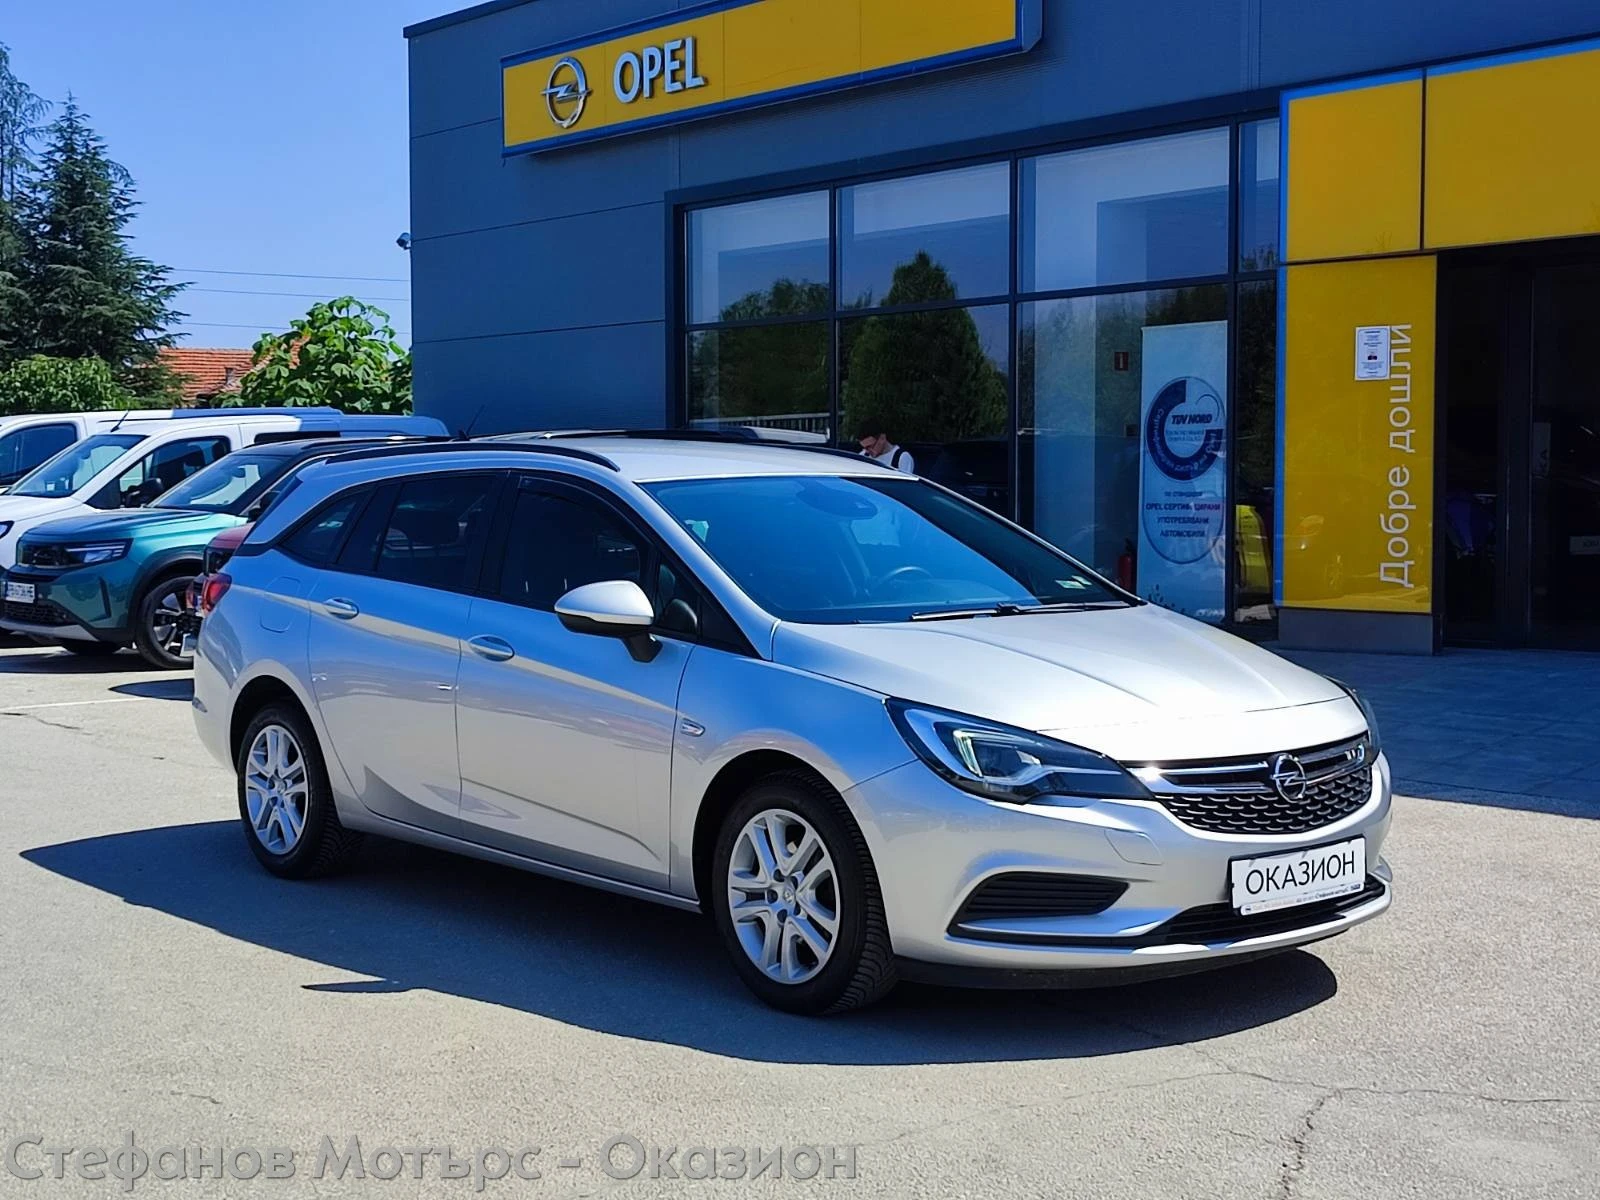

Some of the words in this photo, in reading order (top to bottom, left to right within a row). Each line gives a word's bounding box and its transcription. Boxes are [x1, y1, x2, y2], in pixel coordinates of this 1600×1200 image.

[613, 36, 705, 103] OPEL
[1188, 414, 1212, 424] NORD
[1388, 323, 1416, 453] дошли
[1379, 465, 1416, 588] Добре
[1245, 850, 1355, 895] ОКАЗИОН
